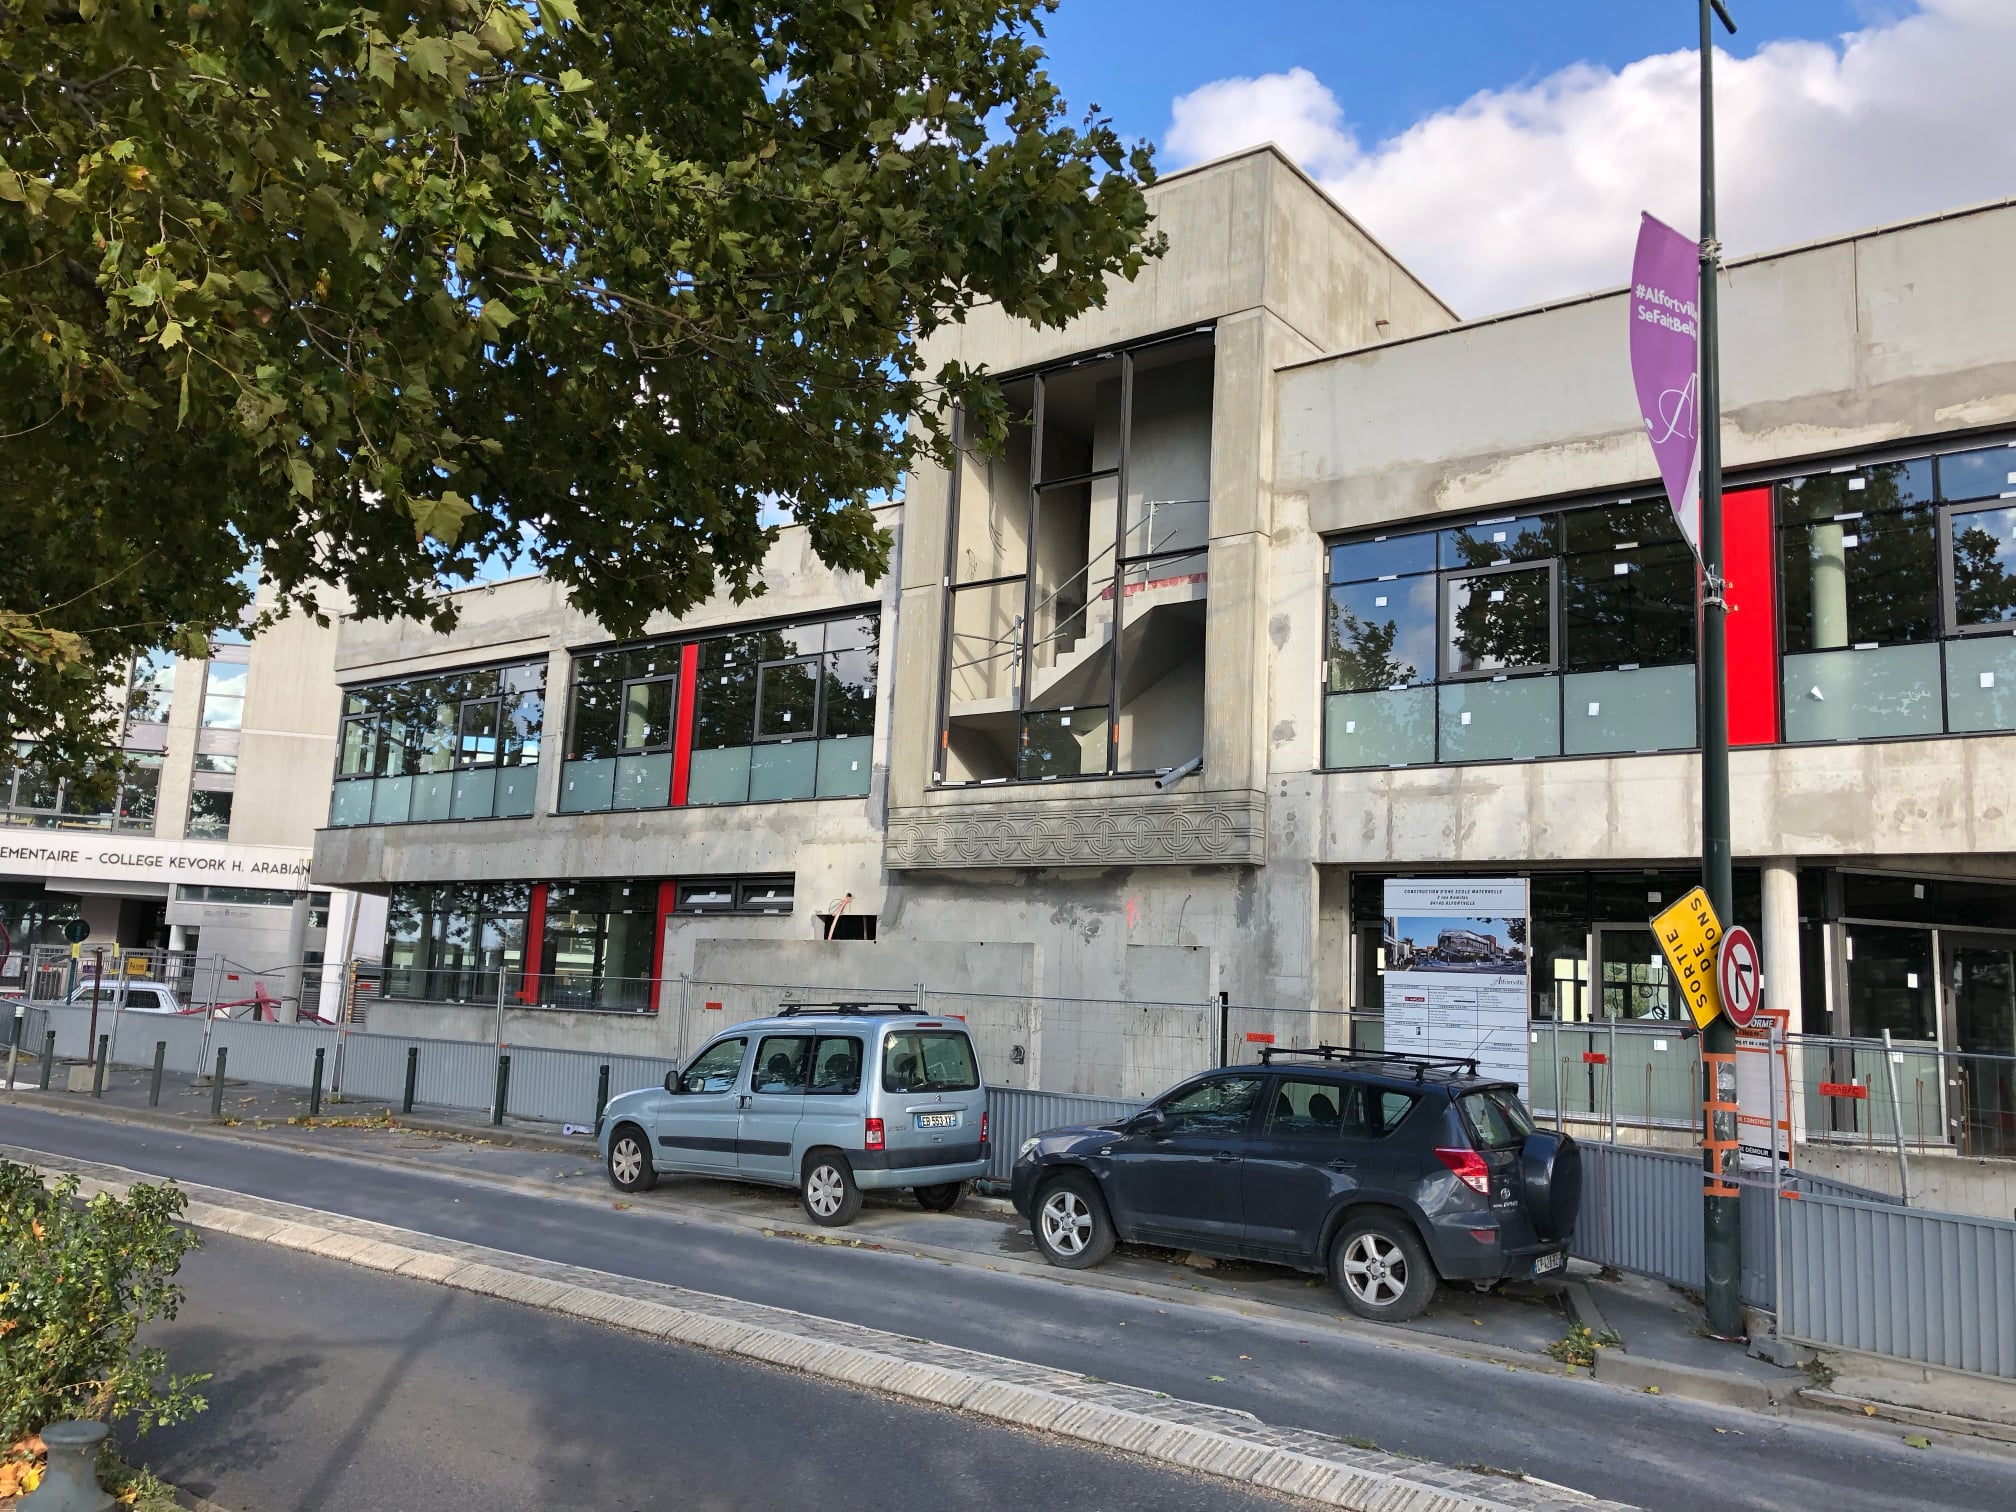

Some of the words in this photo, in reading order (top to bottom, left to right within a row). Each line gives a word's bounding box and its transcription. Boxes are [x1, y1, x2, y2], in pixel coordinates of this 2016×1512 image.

[0, 847, 79, 862] EMENTAIRE
[99, 853, 163, 868] COLLEGE
[169, 857, 226, 872] KEVORK
[232, 860, 244, 872] H.
[251, 862, 310, 875] ARABIAN
[1690, 897, 1720, 960] IONS
[1666, 928, 1708, 1008] SORTIE
[1693, 943, 1711, 973] DE
[1750, 1018, 1775, 1028] ORME
